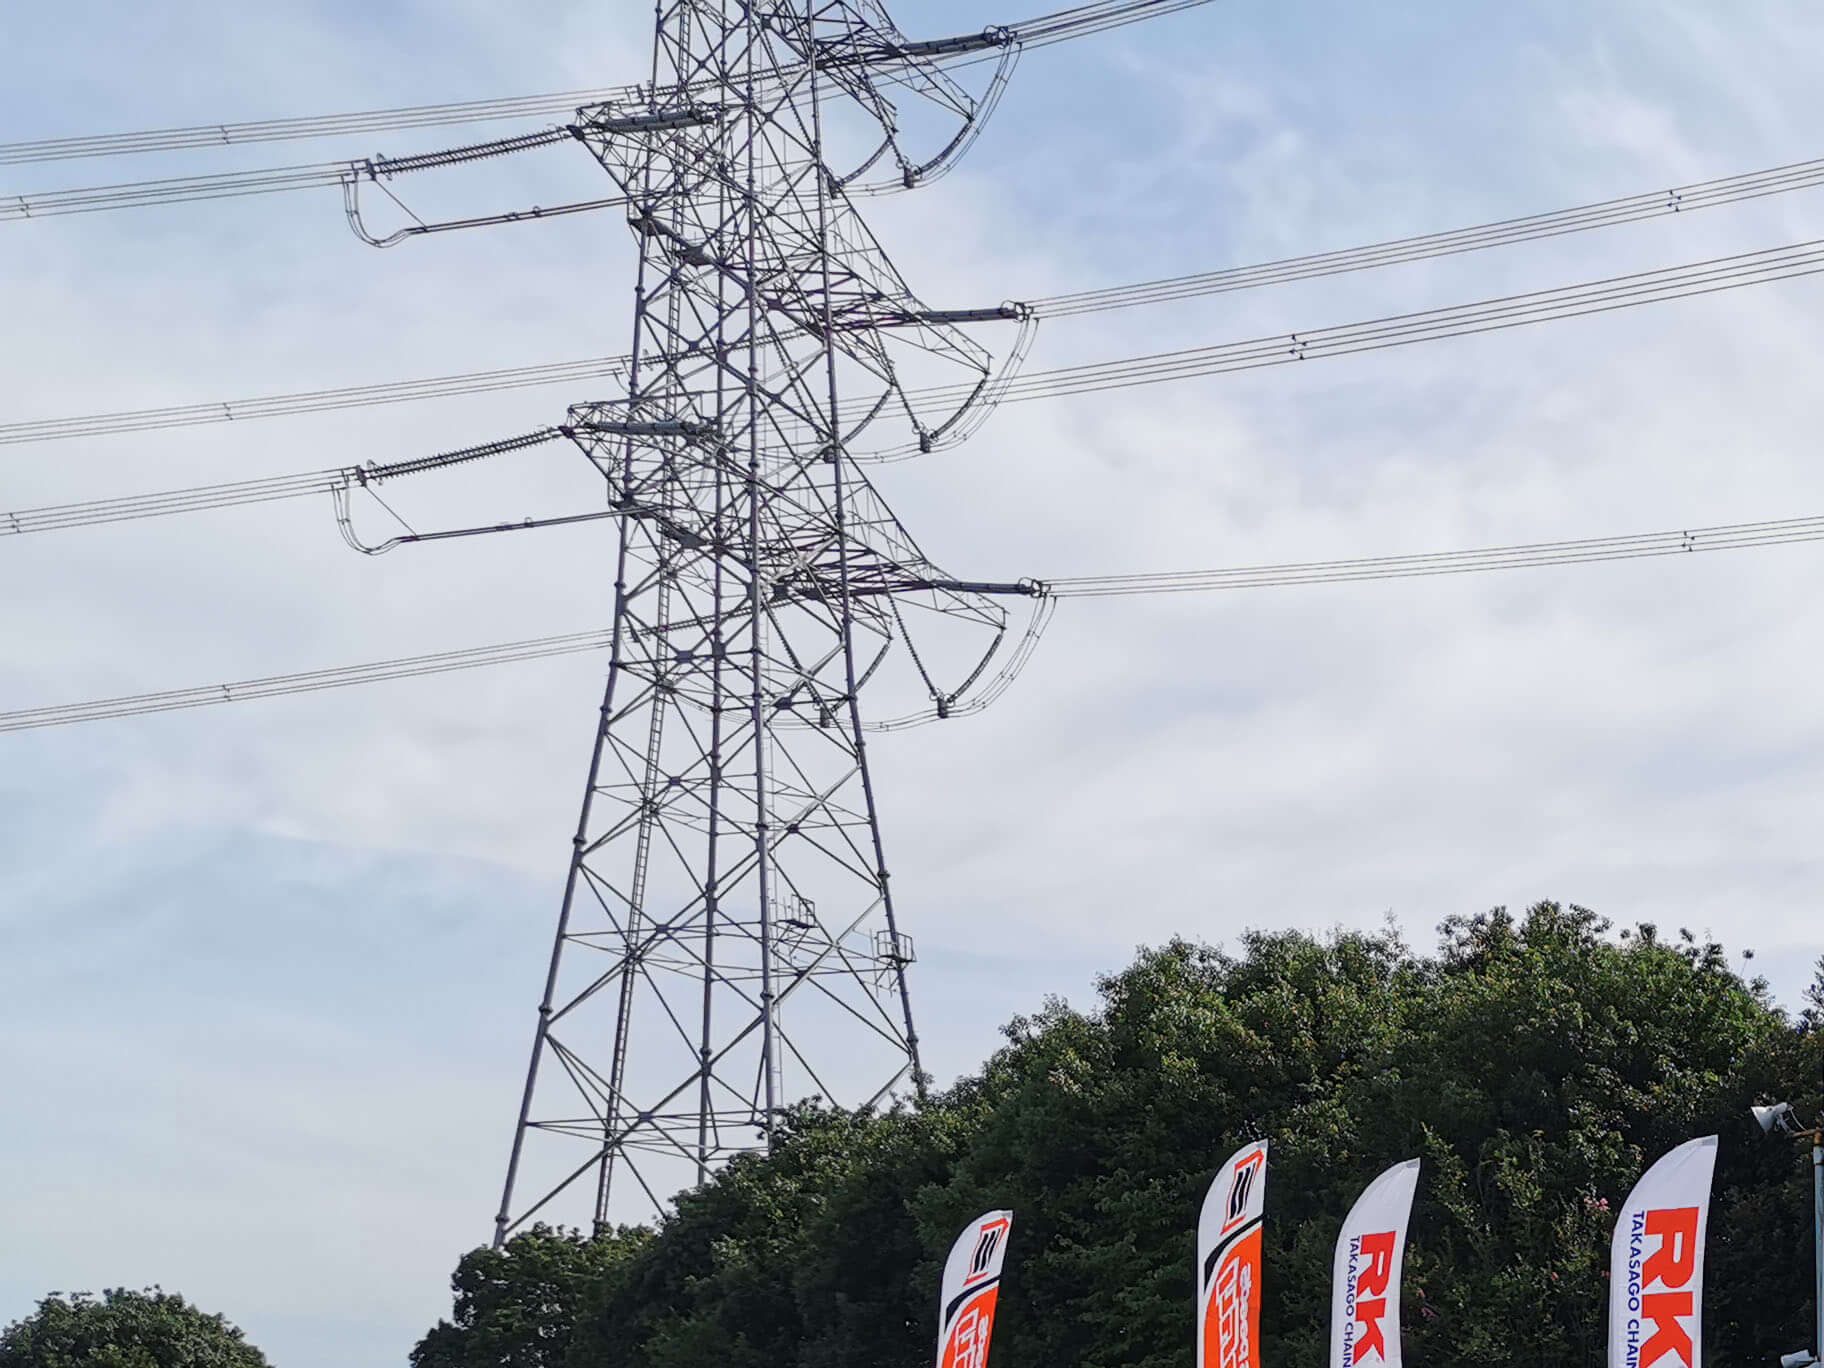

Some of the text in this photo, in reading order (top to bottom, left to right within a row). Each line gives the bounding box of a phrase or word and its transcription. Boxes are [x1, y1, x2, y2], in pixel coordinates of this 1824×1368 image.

[1342, 1235, 1361, 1368] TAKASAGO CHAIN
[1353, 1230, 1397, 1366] RK
[1627, 1210, 1645, 1311] TAKASAGO
